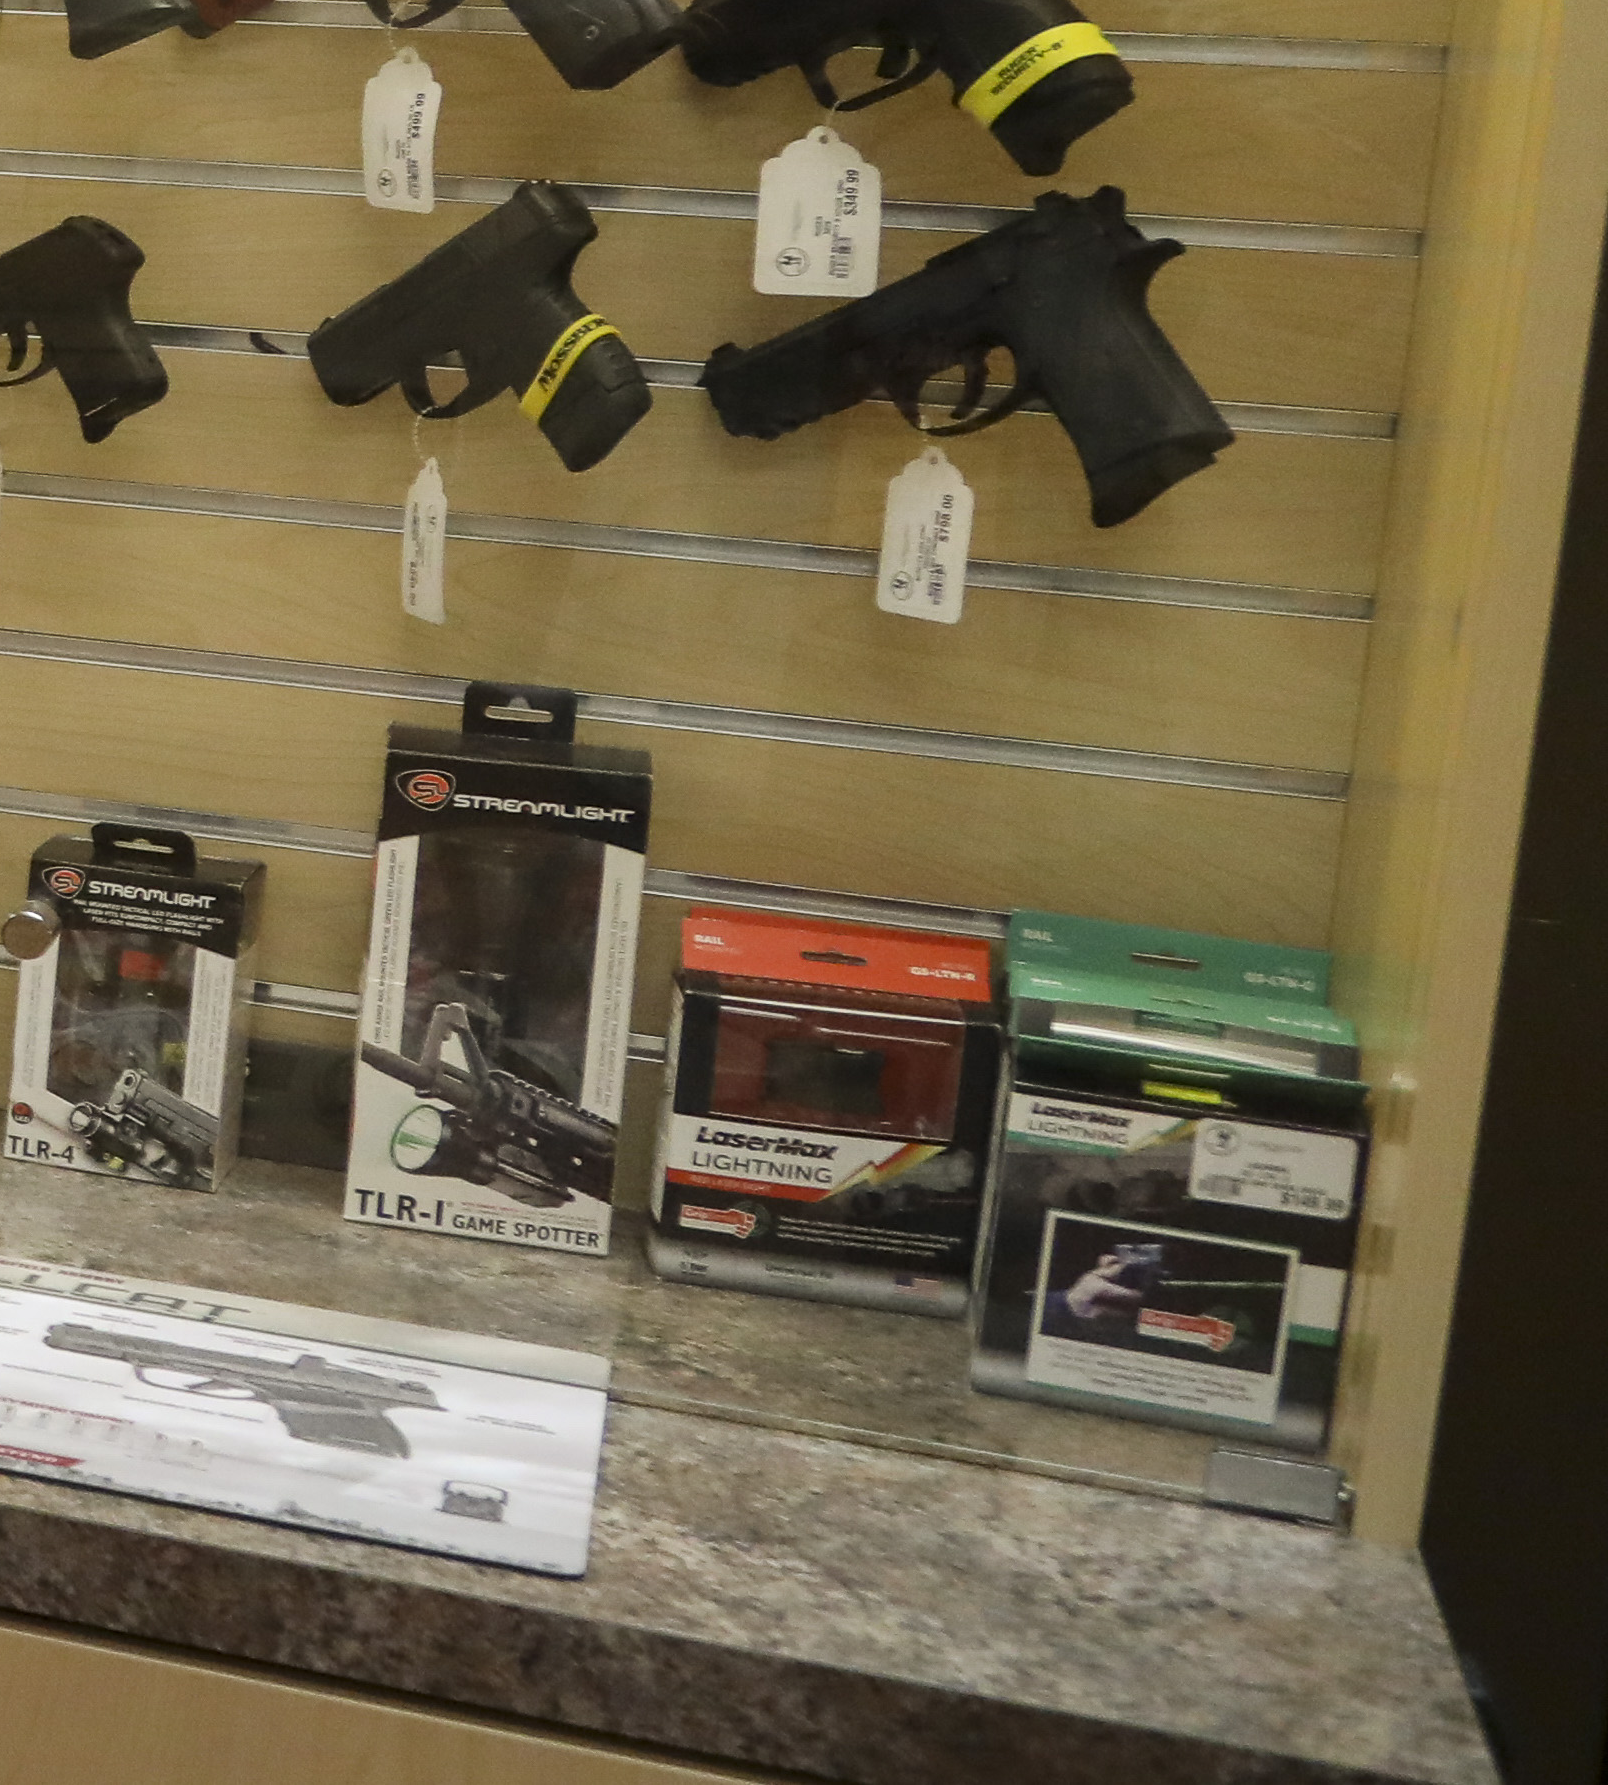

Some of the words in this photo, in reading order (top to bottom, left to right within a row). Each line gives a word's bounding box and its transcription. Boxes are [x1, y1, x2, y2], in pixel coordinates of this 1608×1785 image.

[998, 47, 1036, 78] RUGER
[411, 93, 425, 139] $499.99
[844, 169, 859, 215] $349.99
[453, 794, 635, 823] STREAMLIGHT
[89, 880, 216, 909] STREAMLIGHT
[695, 1125, 838, 1161] LaserMax
[1027, 1118, 1128, 1145] LIGHTNING
[8, 1135, 75, 1163] TLR-4
[692, 1151, 833, 1184] LIGHTNING
[452, 1214, 507, 1235] GAME
[513, 1222, 599, 1248] SPOTTER
